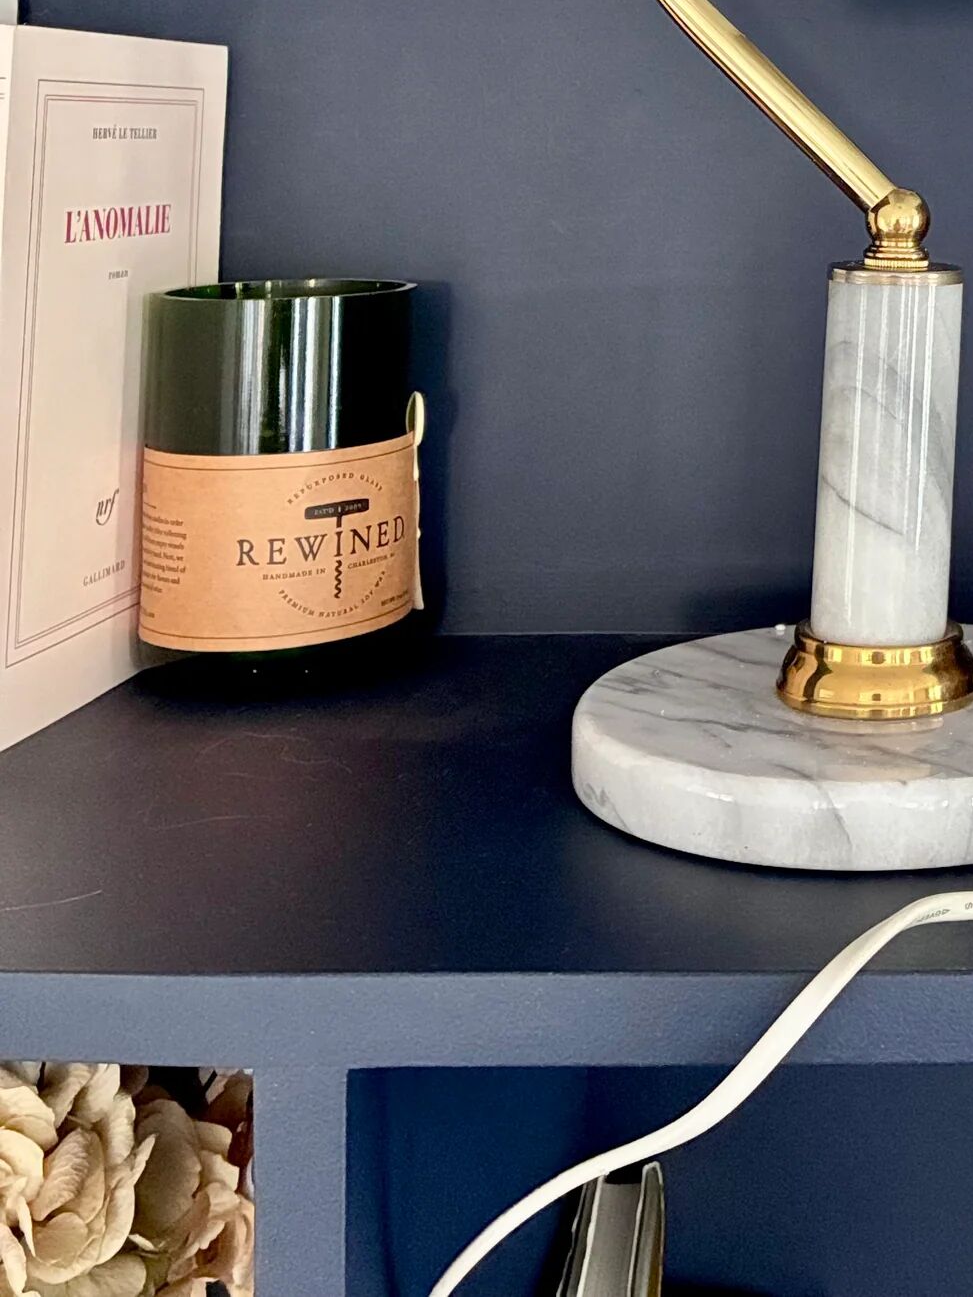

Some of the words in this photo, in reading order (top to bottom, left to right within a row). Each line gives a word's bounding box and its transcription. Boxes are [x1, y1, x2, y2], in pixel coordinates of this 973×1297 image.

[93, 124, 117, 139] HERVÉ
[119, 128, 127, 139] LE
[129, 127, 157, 139] TELLIER
[64, 204, 172, 244] L'ANOMALIE
[108, 269, 129, 280] roman
[287, 473, 354, 504] REPURPOSED
[236, 515, 405, 566] REWINED
[83, 559, 125, 587] GALLIMARD
[262, 569, 313, 580] HANDMADE
[279, 589, 315, 616] PREMIUM
[318, 604, 359, 618] NATURAL
